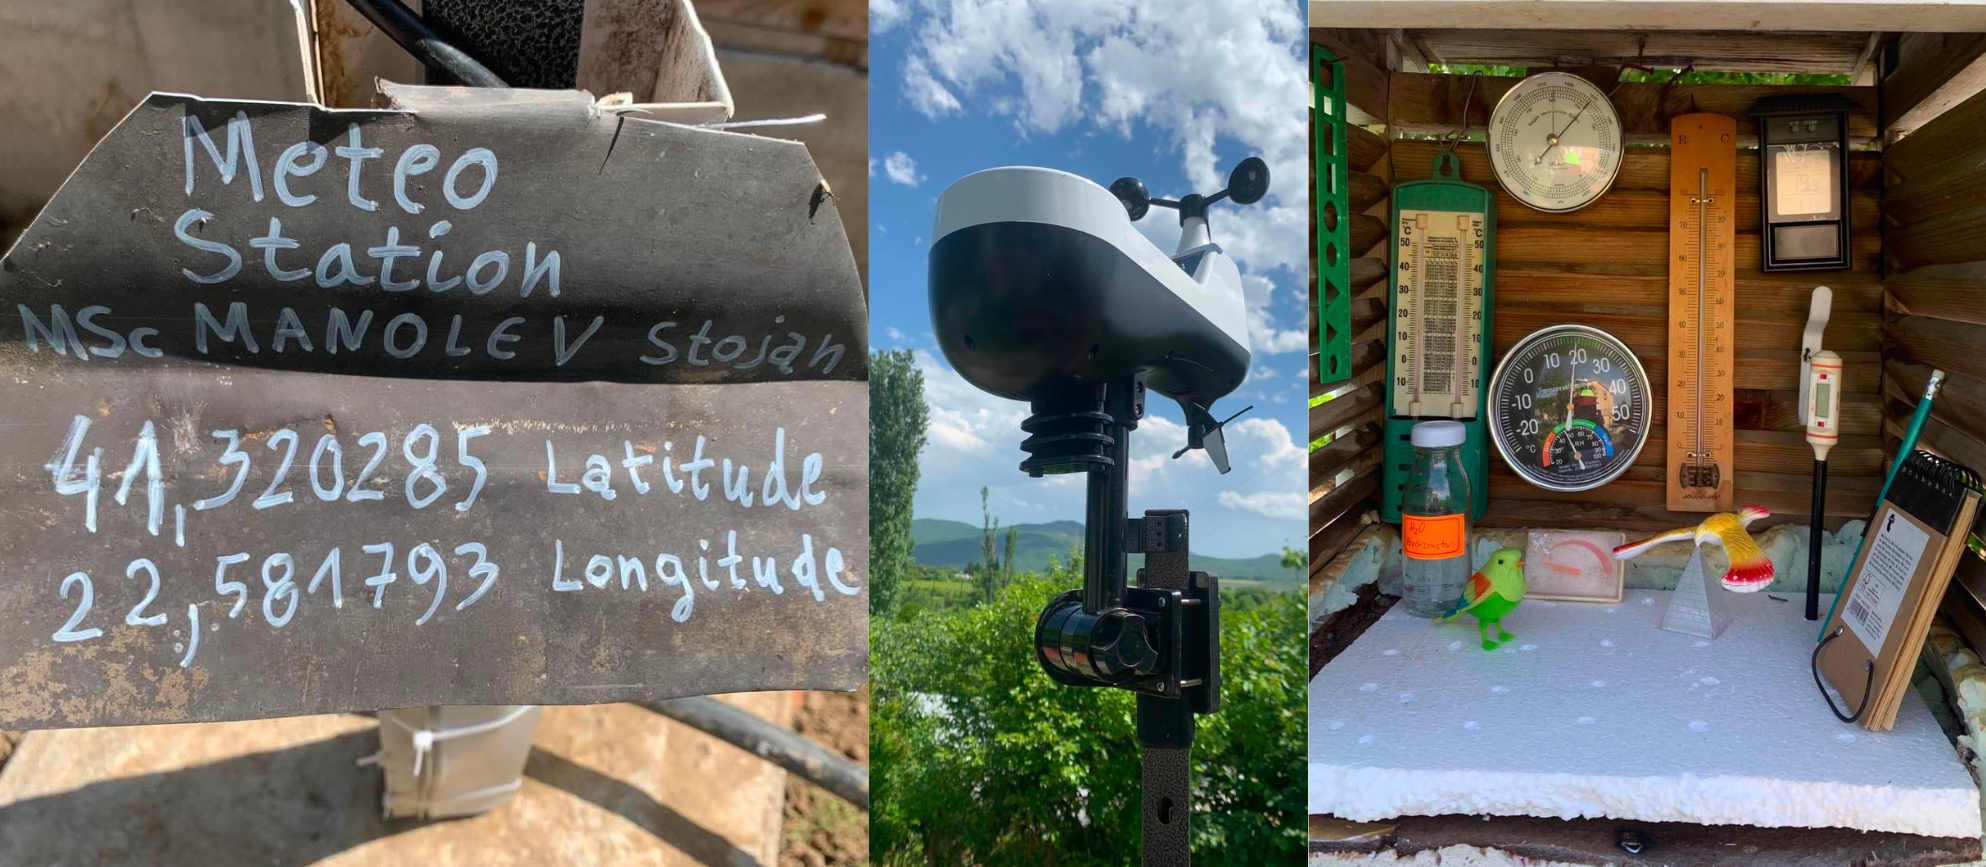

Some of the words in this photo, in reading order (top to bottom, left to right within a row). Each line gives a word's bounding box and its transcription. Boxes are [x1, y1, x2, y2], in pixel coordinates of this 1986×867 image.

[1678, 135, 1688, 144] R
[1721, 134, 1730, 143] C
[182, 111, 498, 214] Meteo
[1400, 238, 1410, 247] 50
[1475, 240, 1484, 249] 50
[173, 209, 561, 297] Station
[1399, 262, 1409, 271] 40
[1474, 265, 1483, 273] 40
[1399, 285, 1409, 294] 30
[1473, 288, 1482, 296] 30
[1398, 309, 1408, 317] 20
[1473, 311, 1481, 320] 20
[17, 303, 164, 361] MSc
[194, 302, 602, 366] MANOLEV
[639, 314, 846, 375] Stojan
[1398, 332, 1408, 341] 10
[1472, 334, 1481, 343] 10
[1401, 355, 1406, 364] 0
[1472, 357, 1477, 366] 0
[1543, 353, 1560, 369] 10
[1569, 349, 1587, 365] 20
[1592, 357, 1610, 374] 30
[1524, 368, 1534, 383] 0
[1397, 377, 1406, 386] 10
[1471, 379, 1479, 388] 10
[1609, 379, 1626, 394] 40
[1511, 394, 1532, 410] -10
[1612, 404, 1630, 421] 50
[1516, 419, 1539, 436] -20
[1526, 444, 1536, 454] °C
[45, 415, 490, 546] 41,320285
[545, 428, 824, 513] Latitude
[53, 542, 499, 668] 22,581793
[553, 531, 861, 622] Longitude
